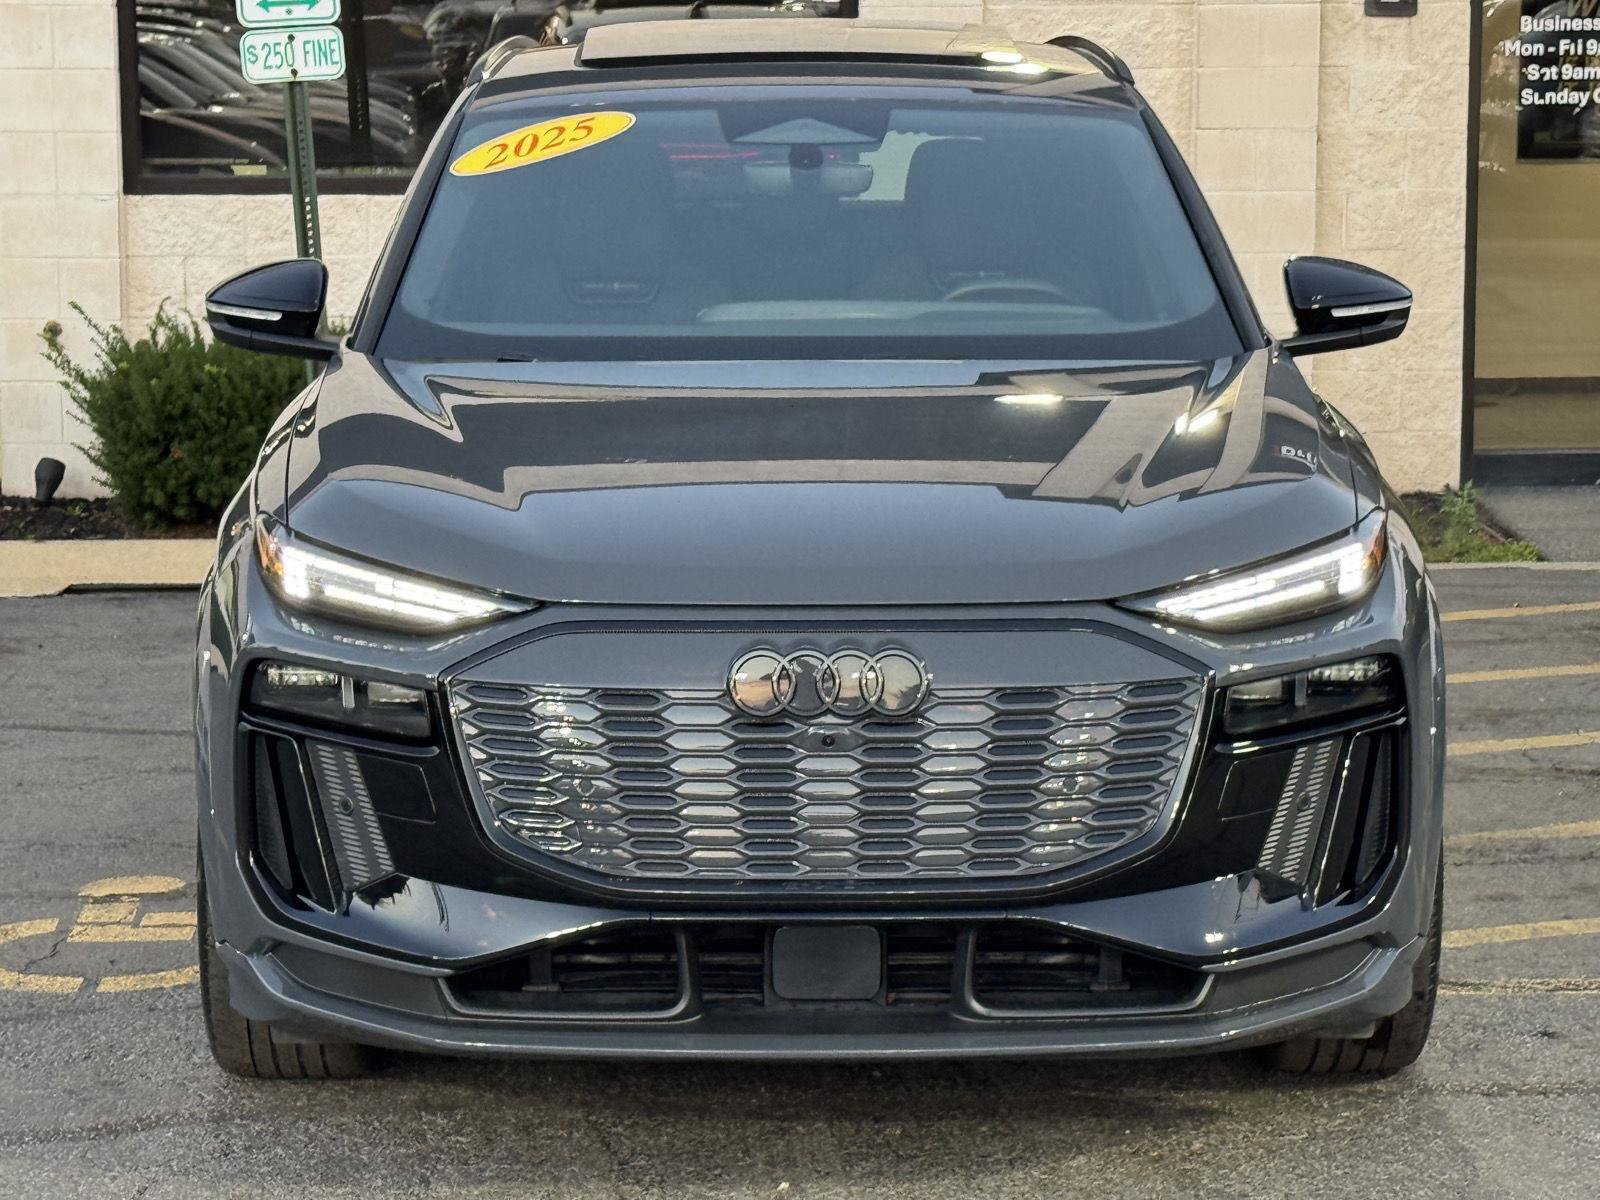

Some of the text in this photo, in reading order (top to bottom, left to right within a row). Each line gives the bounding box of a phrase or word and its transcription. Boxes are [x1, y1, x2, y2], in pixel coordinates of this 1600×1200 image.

[1520, 15, 1600, 32] Business
[246, 38, 340, 70] $250 FINE
[1504, 39, 1545, 56] Mon
[1520, 87, 1591, 108] Sunday
[484, 116, 596, 170] 2025
